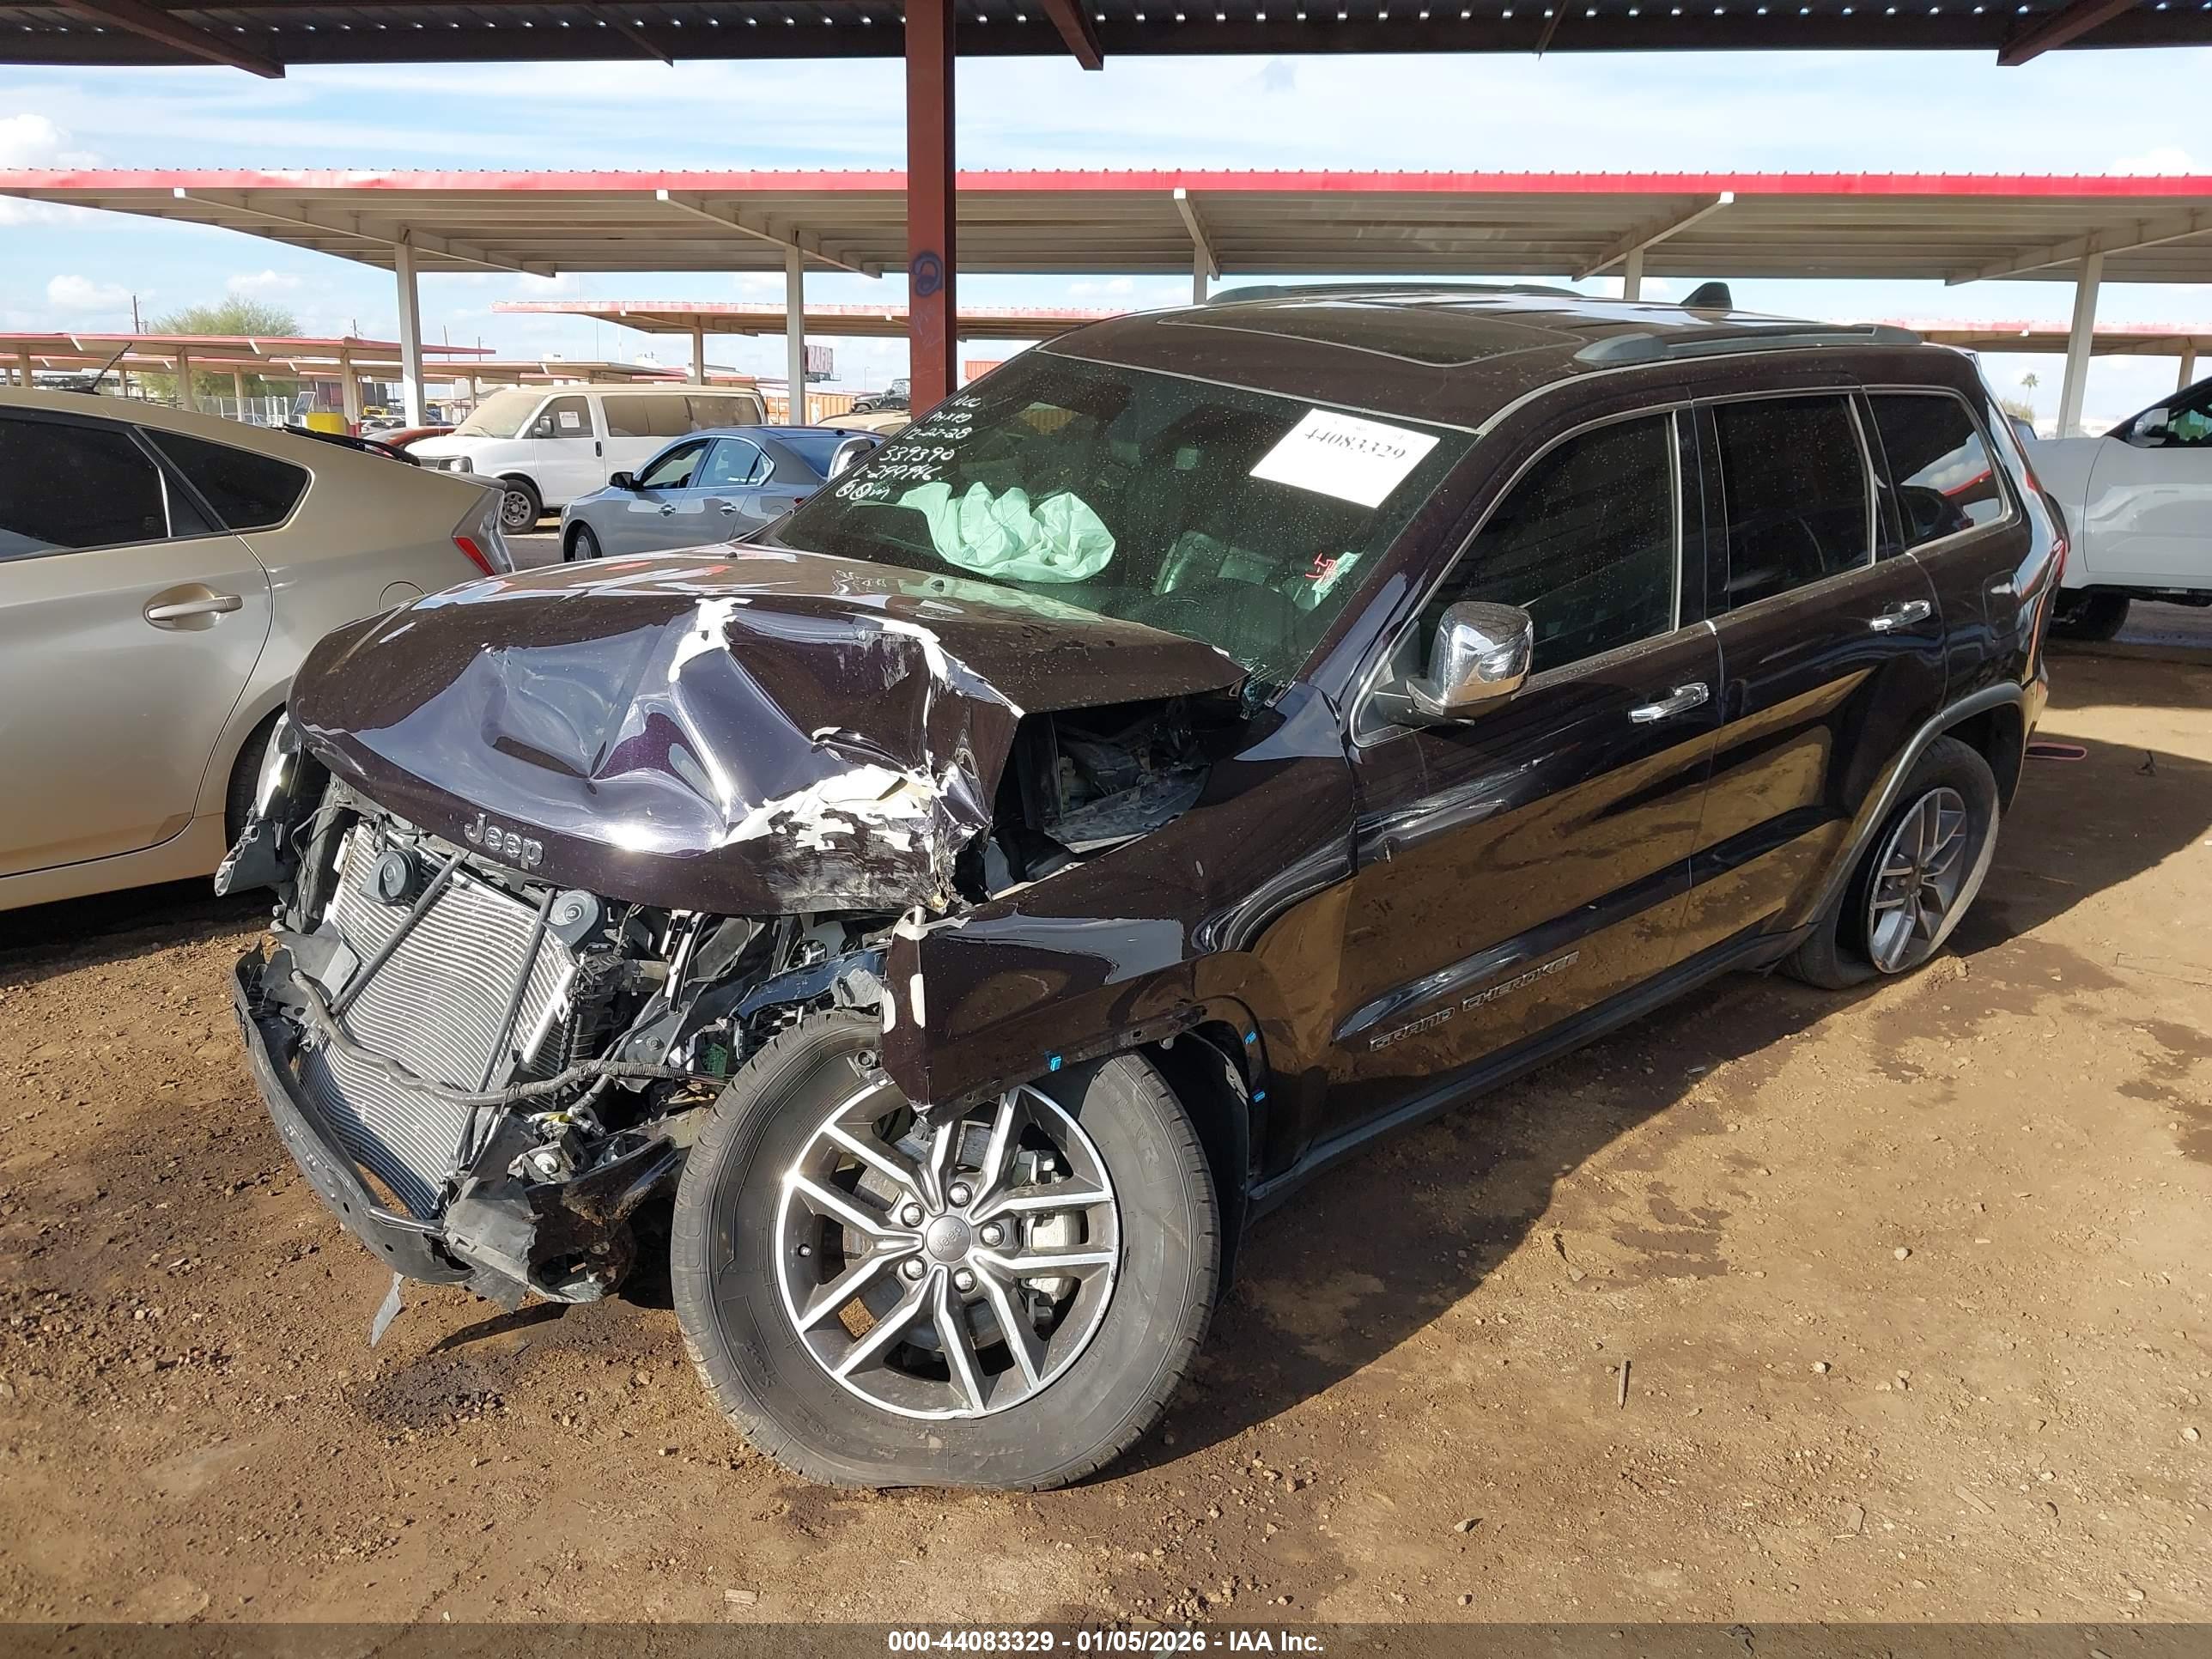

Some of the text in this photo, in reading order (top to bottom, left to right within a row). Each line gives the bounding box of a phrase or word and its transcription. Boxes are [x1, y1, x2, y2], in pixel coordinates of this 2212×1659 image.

[1304, 426, 1407, 459] 44083329
[464, 812, 544, 871] Jeep
[1369, 950, 1580, 1052] GRAND CHEROKEE
[934, 1224, 963, 1254] Jeep
